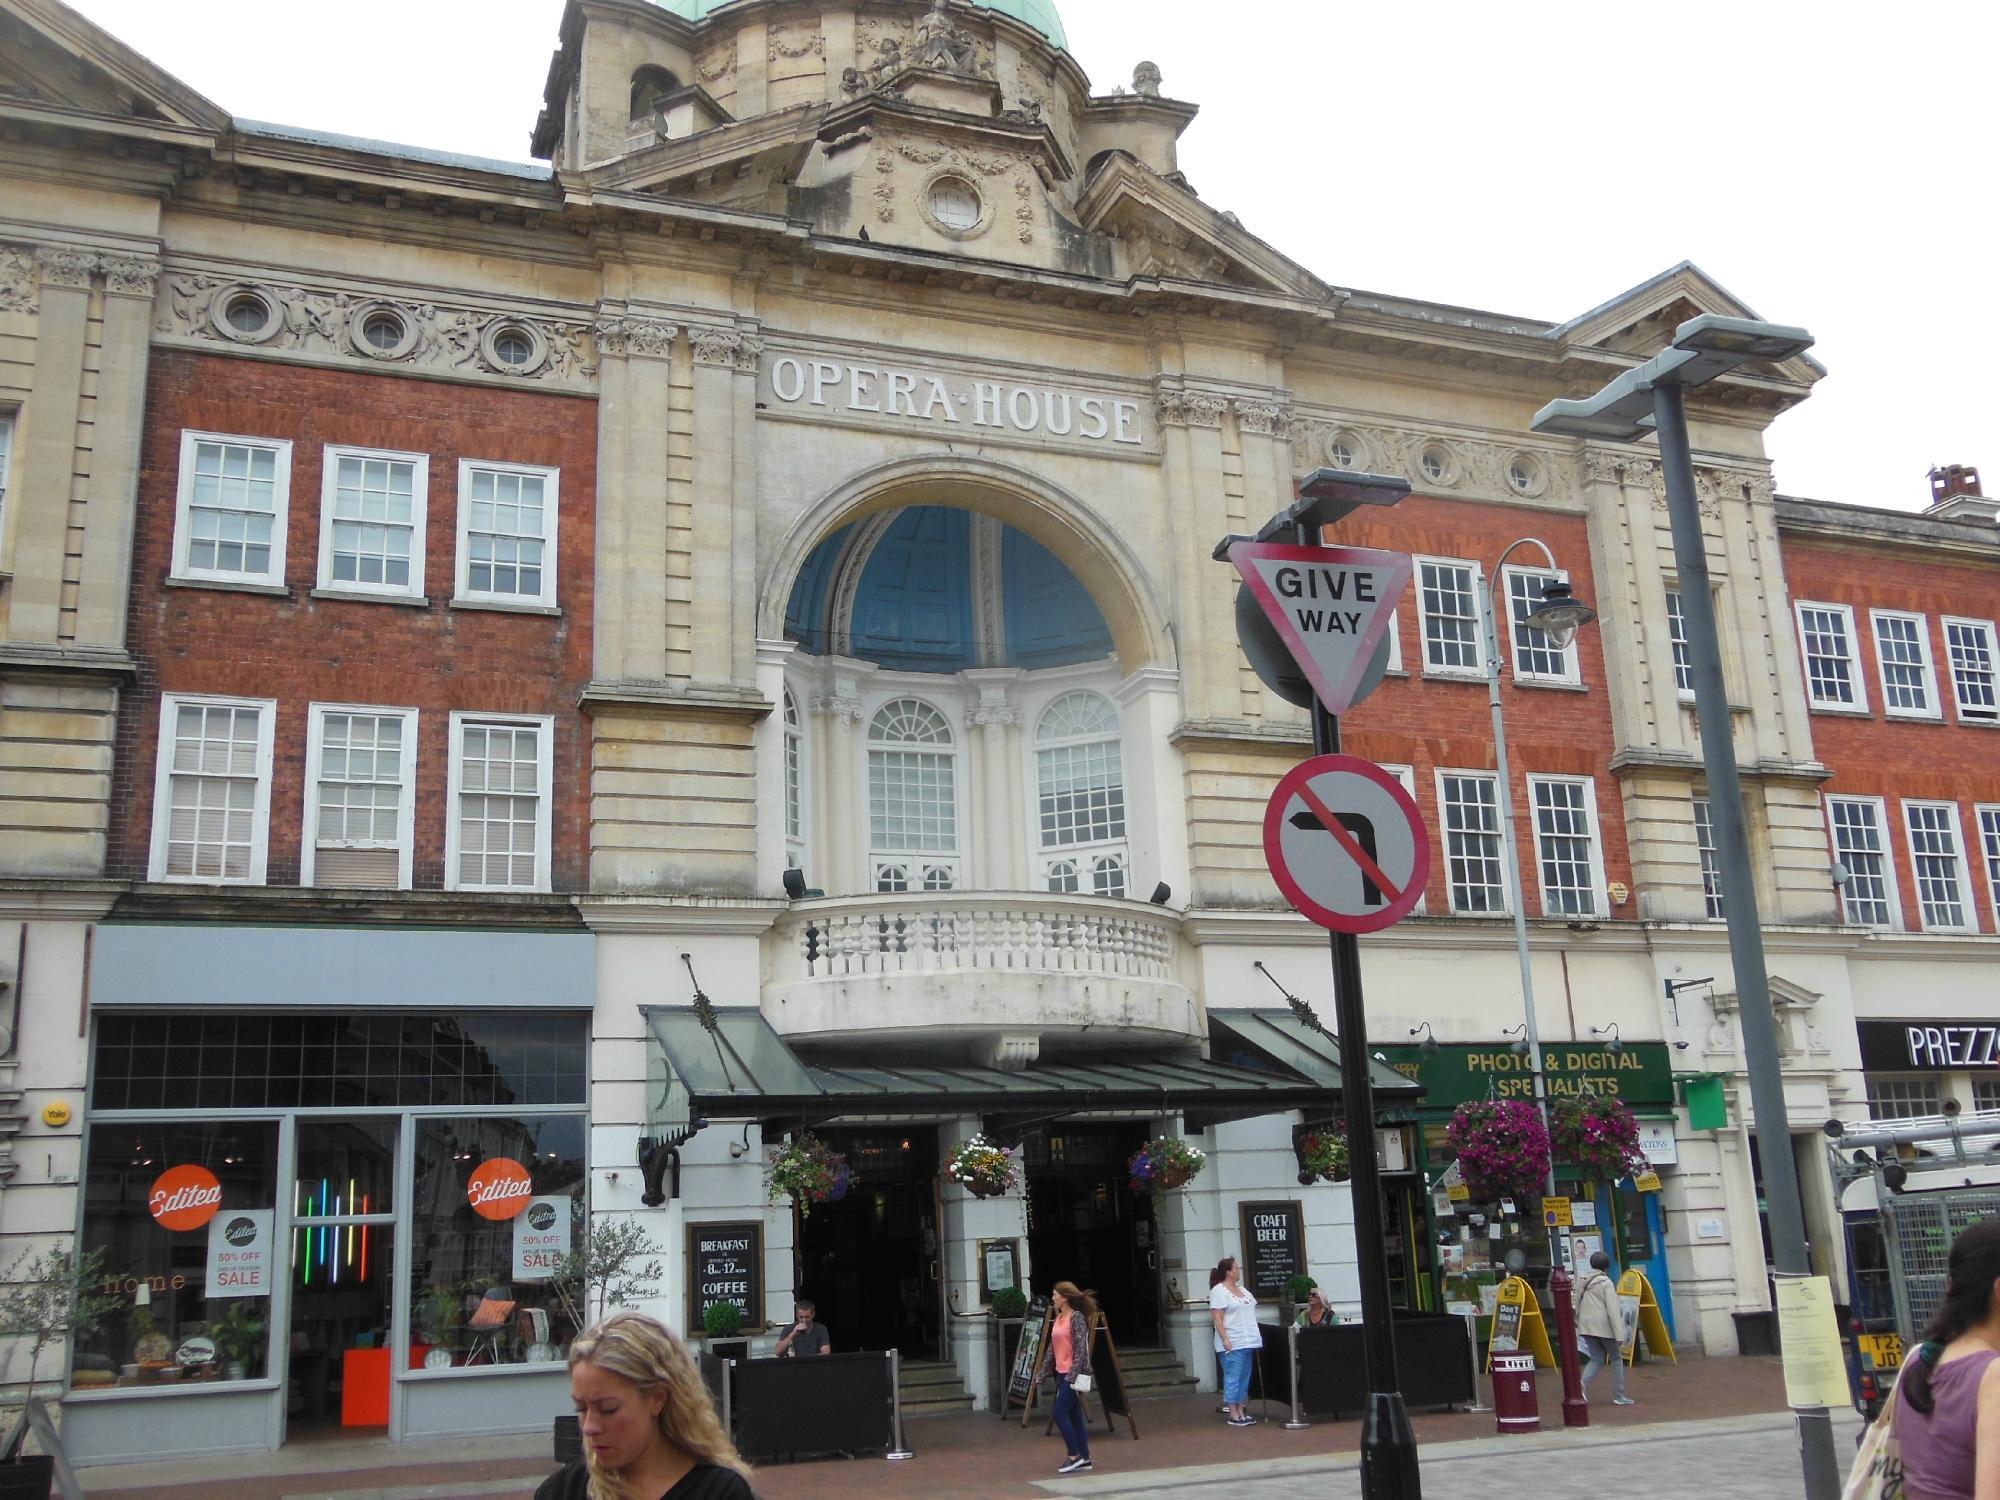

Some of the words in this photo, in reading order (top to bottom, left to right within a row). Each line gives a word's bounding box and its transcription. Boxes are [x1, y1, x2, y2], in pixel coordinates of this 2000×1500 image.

[972, 382, 1143, 445] HOUSE
[1275, 567, 1377, 603] GIVE
[1296, 608, 1362, 635] WAY
[1905, 1027, 2000, 1066] PREZZ
[1545, 1053, 1560, 1071] &
[1566, 1052, 1643, 1070] DIGITAL
[1498, 1077, 1619, 1097] SPEIALISTS
[468, 1177, 532, 1207] Edited
[149, 1184, 223, 1218] Edited
[529, 1210, 557, 1226] Edited
[1253, 1214, 1288, 1228] CRAFT
[225, 1225, 258, 1242] Edited
[523, 1235, 541, 1245] 50%
[542, 1235, 561, 1244] OFF
[1256, 1228, 1287, 1242] BEER
[700, 1240, 750, 1252] BREAKFAST
[218, 1252, 239, 1262] 50%
[240, 1251, 262, 1262] OFF
[523, 1254, 562, 1267] SALE
[217, 1271, 260, 1286] SALE
[702, 1281, 748, 1294] COFFEE
[1500, 1304, 1519, 1314] Don't
